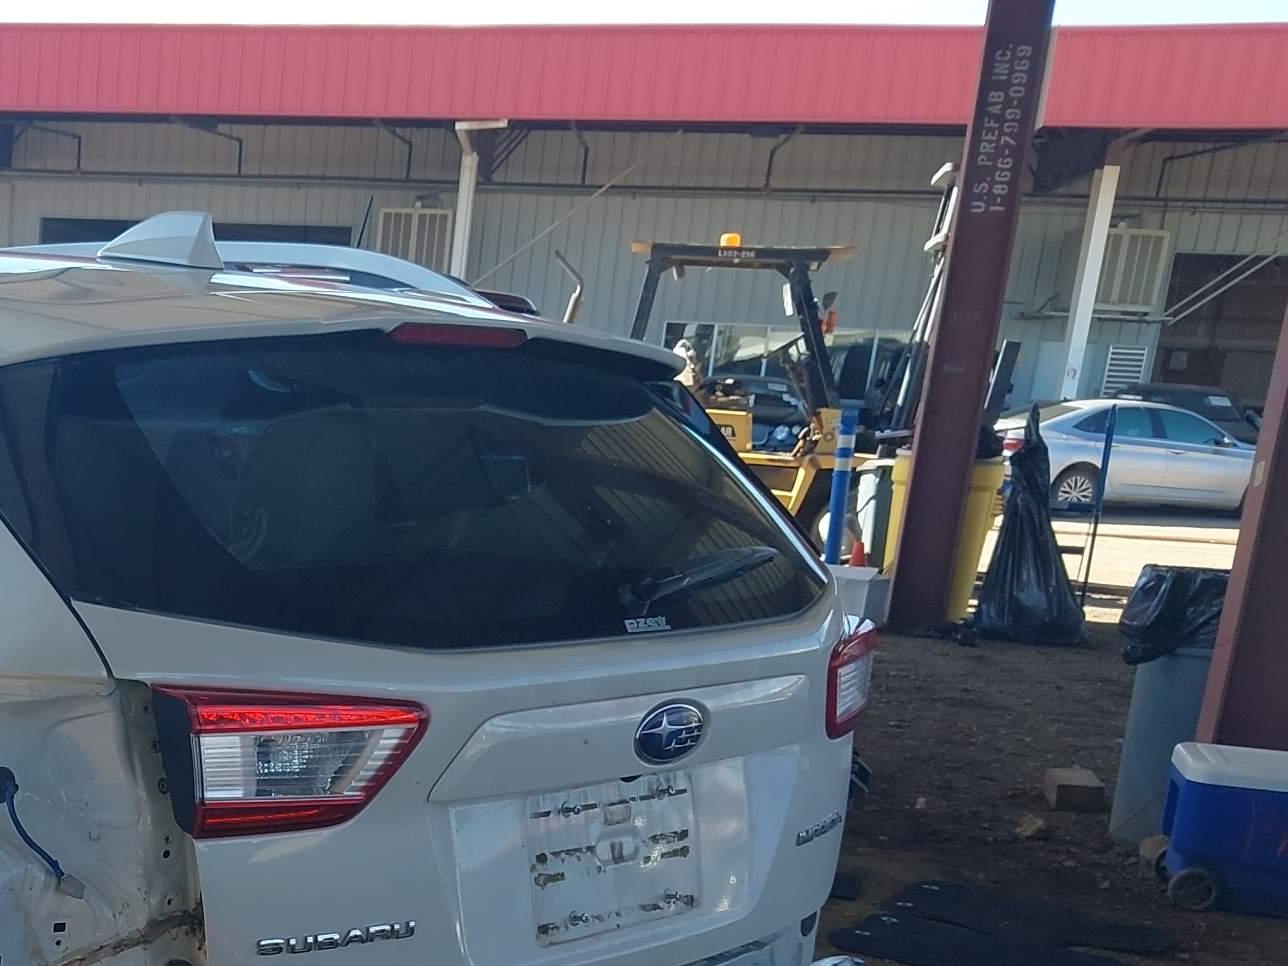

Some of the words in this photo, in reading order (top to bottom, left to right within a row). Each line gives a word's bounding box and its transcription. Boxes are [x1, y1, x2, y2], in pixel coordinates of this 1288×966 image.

[992, 43, 1013, 80] INC.
[977, 90, 1005, 166] PREFAB
[989, 45, 1032, 211] 1-866-799-0969
[970, 177, 990, 213] U.S.
[256, 920, 416, 956] SUBARU
